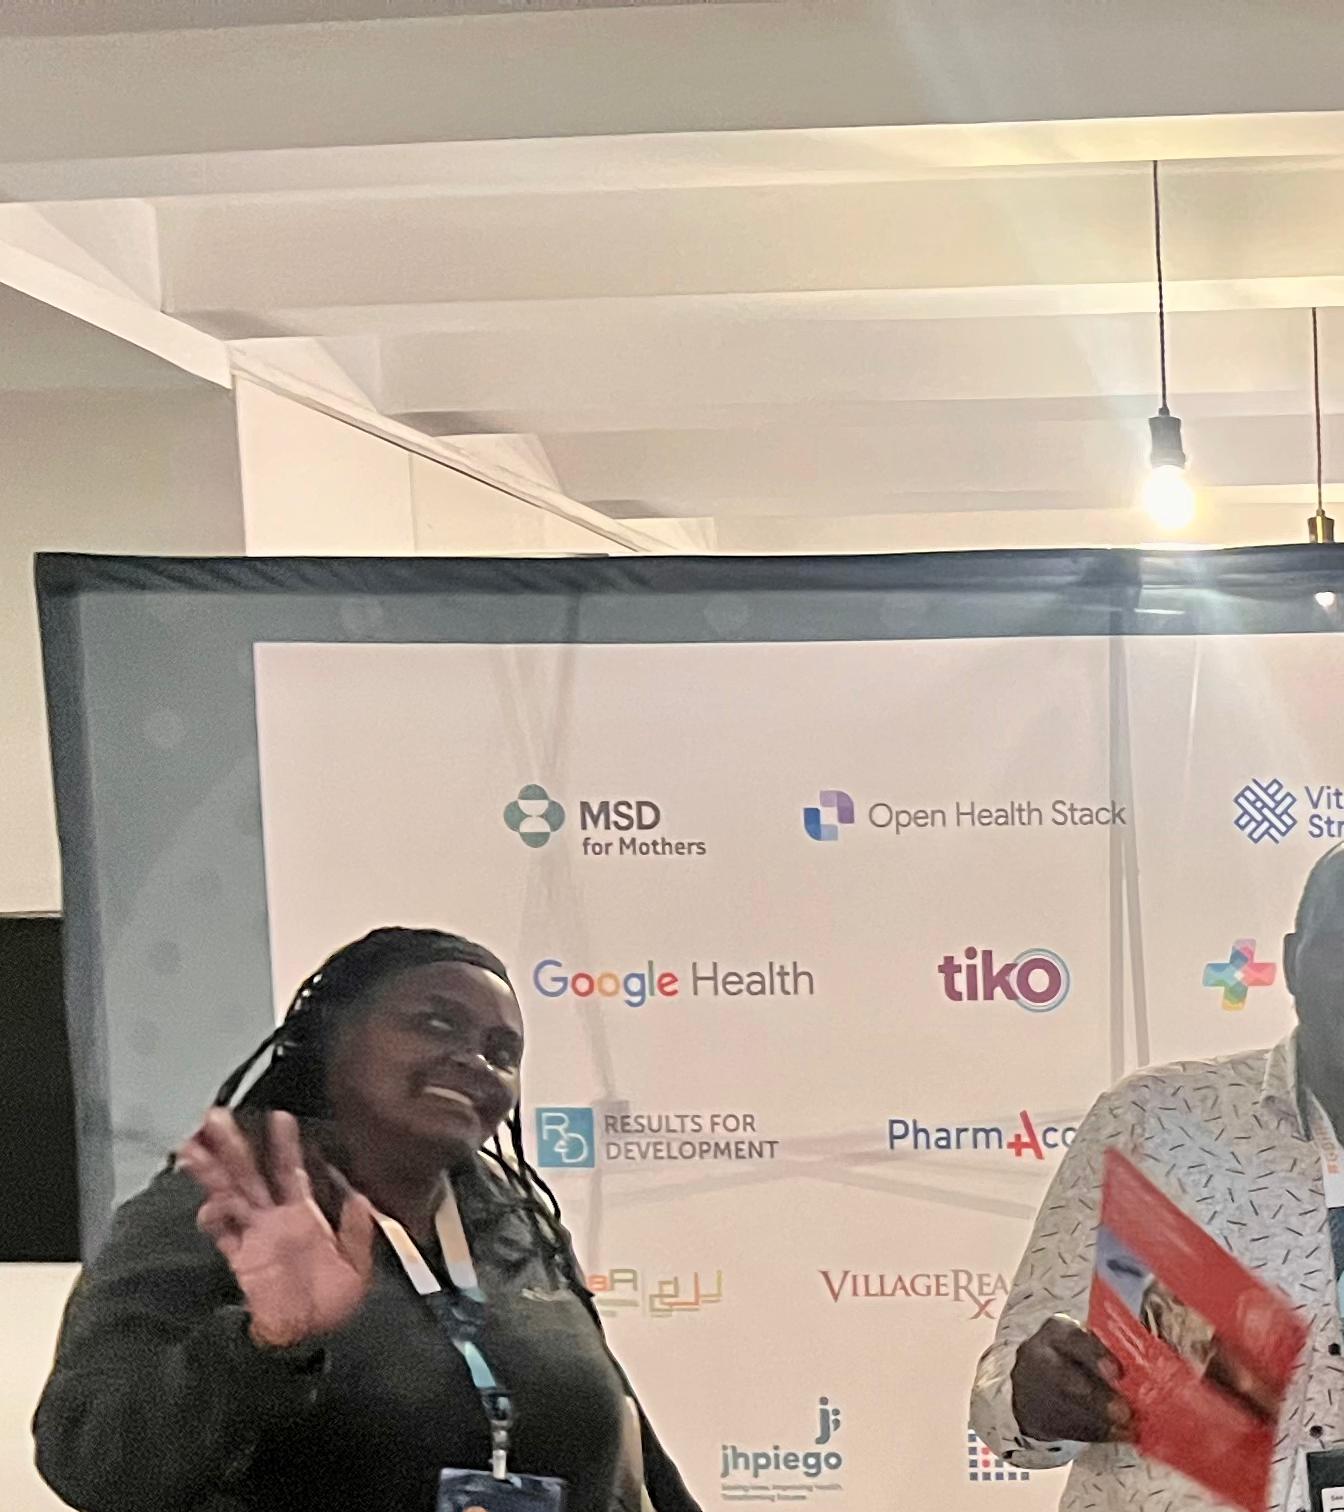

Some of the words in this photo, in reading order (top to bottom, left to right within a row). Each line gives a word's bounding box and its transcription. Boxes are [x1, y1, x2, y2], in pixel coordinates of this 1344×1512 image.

[580, 801, 661, 830] MSD
[869, 803, 946, 835] Open
[956, 801, 1043, 827] Health
[1051, 799, 1126, 826] Stack
[583, 837, 613, 855] for
[619, 837, 706, 855] Mothers
[533, 959, 679, 1008] Google
[692, 960, 814, 996] Health
[938, 946, 1063, 1004] tiko
[604, 1114, 703, 1134] RESULTS
[710, 1114, 756, 1133] FOR
[605, 1140, 779, 1160] DEVELOPMENT
[720, 1445, 842, 1478] jhpiego
